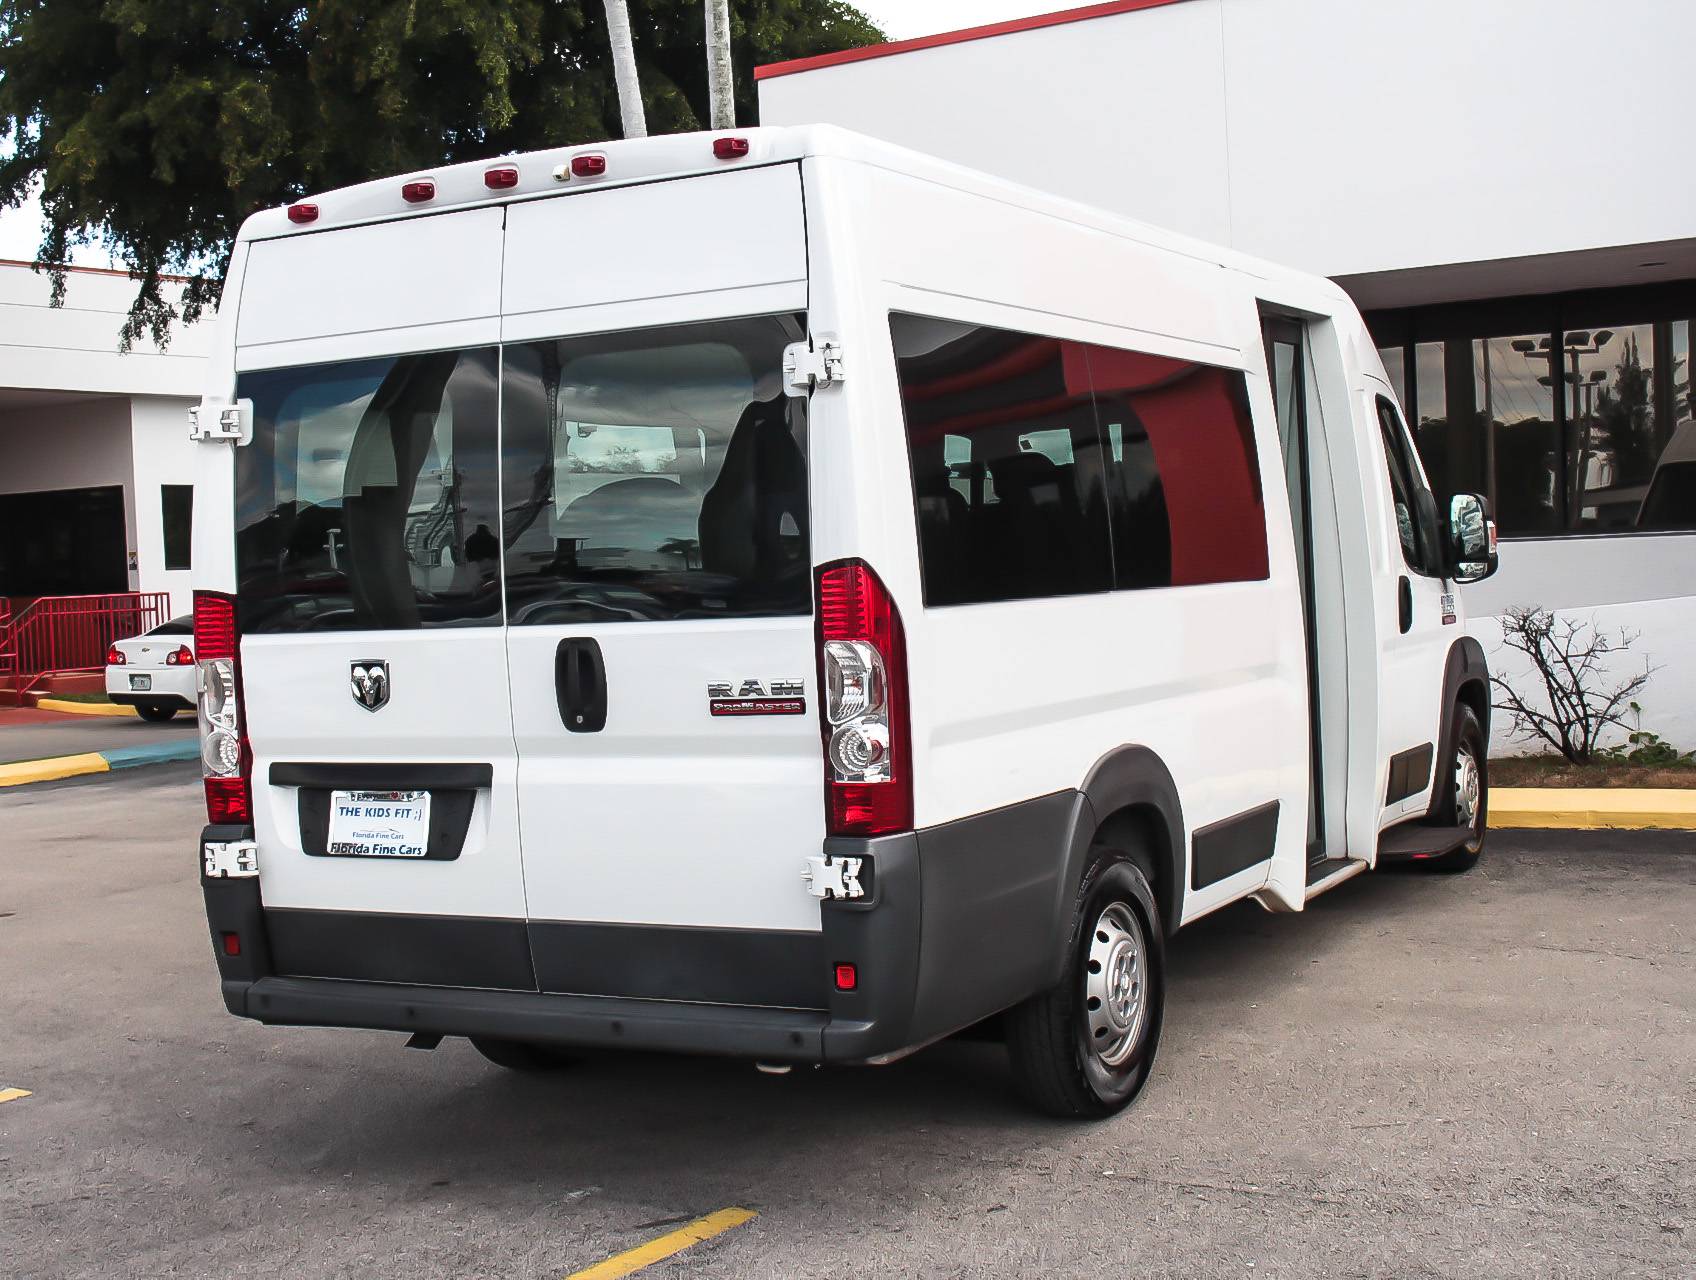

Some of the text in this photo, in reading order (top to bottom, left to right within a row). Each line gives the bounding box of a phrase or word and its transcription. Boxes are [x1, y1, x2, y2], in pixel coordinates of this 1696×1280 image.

[706, 679, 805, 698] RAM
[339, 806, 361, 817] THE
[365, 807, 391, 818] KIDS
[394, 808, 412, 819] FIT
[352, 832, 374, 840] Florida
[375, 832, 389, 840] Fine
[330, 842, 422, 856] Florida Fine Cars
